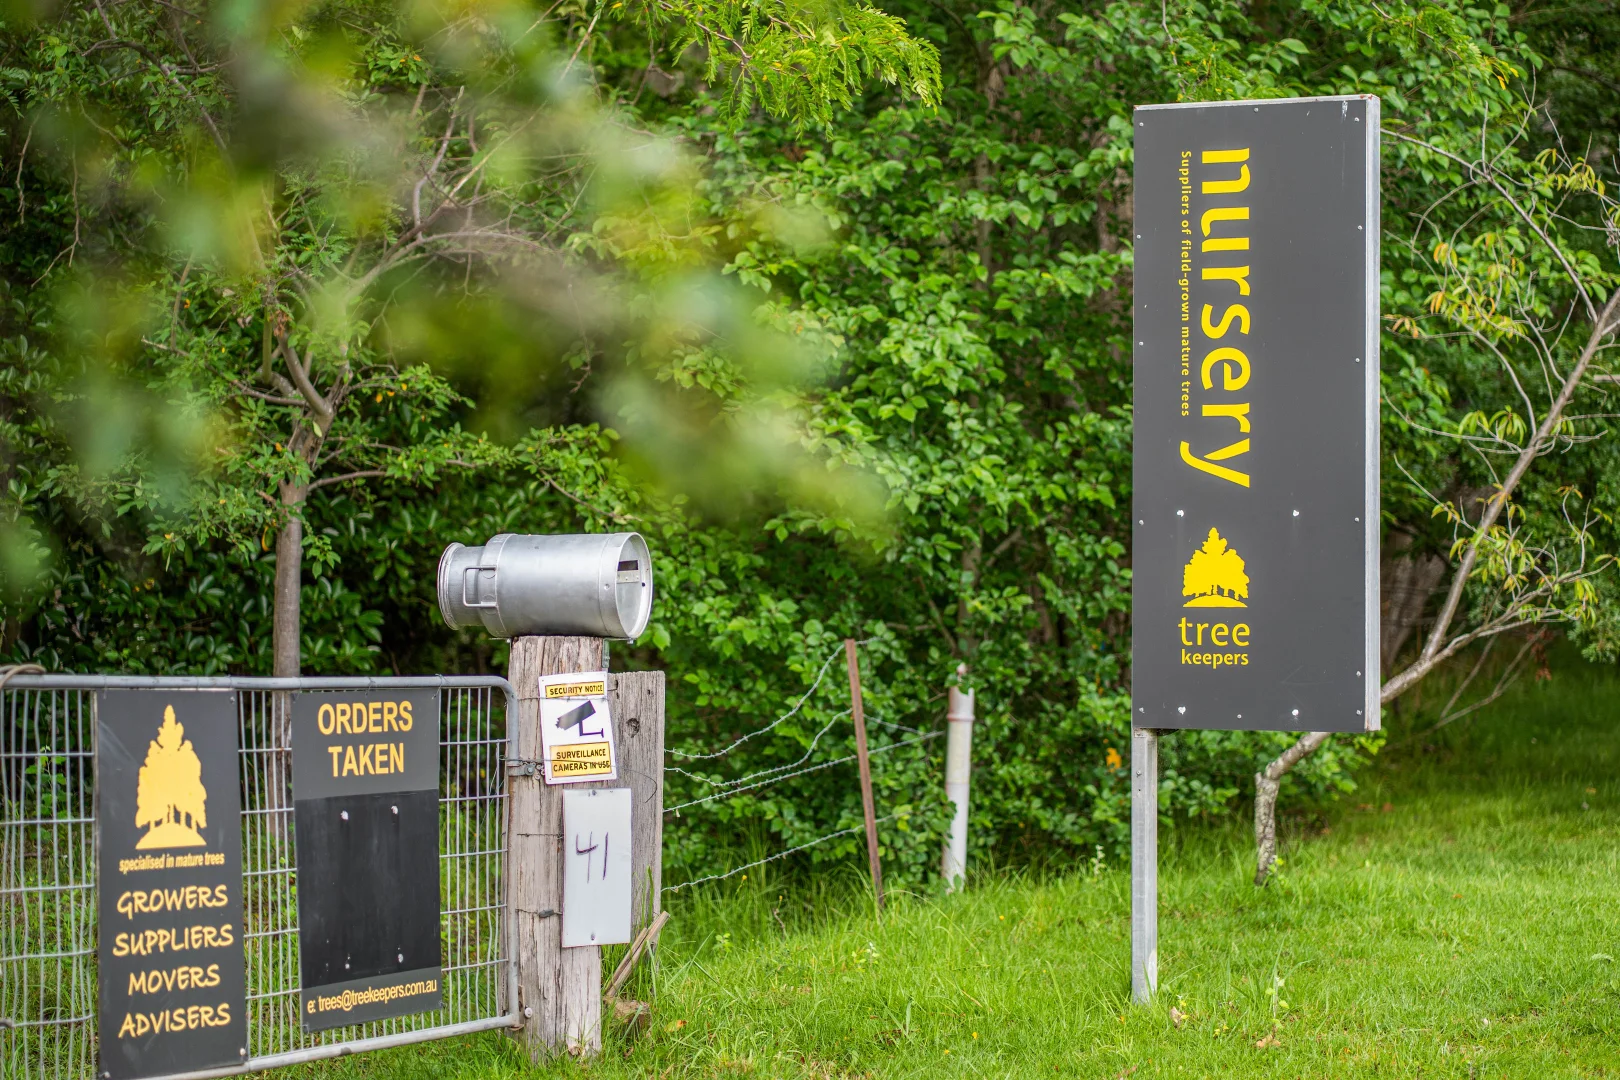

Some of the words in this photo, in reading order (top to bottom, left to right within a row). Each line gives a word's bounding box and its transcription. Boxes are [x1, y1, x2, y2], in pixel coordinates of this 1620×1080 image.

[1179, 151, 1192, 215] Suppliers
[1181, 220, 1192, 235] of
[1179, 240, 1192, 321] field-grown
[1180, 148, 1251, 488] nursery
[1181, 327, 1191, 376] mature
[1181, 381, 1191, 416] trees
[1178, 617, 1250, 646] tree
[1181, 649, 1249, 669] keepers
[550, 686, 582, 695] SECURITY
[585, 684, 603, 692] NOTICE
[317, 700, 413, 735] ORDERS
[328, 742, 405, 777] TAKEN
[553, 762, 588, 772] CAMERAS
[590, 761, 597, 769] IN
[556, 749, 606, 759] SURVEILLANCE
[119, 853, 165, 875] specialised
[166, 853, 174, 868] in
[175, 853, 204, 867] mature
[204, 851, 225, 866] trees
[576, 831, 609, 883] 41
[116, 885, 228, 919] GROWERS
[112, 924, 234, 957] SUPPLIERS
[128, 964, 221, 996] MOVERS
[318, 979, 438, 1011] trees@treekeepers.com.au
[118, 1003, 231, 1039] ADVISERS
